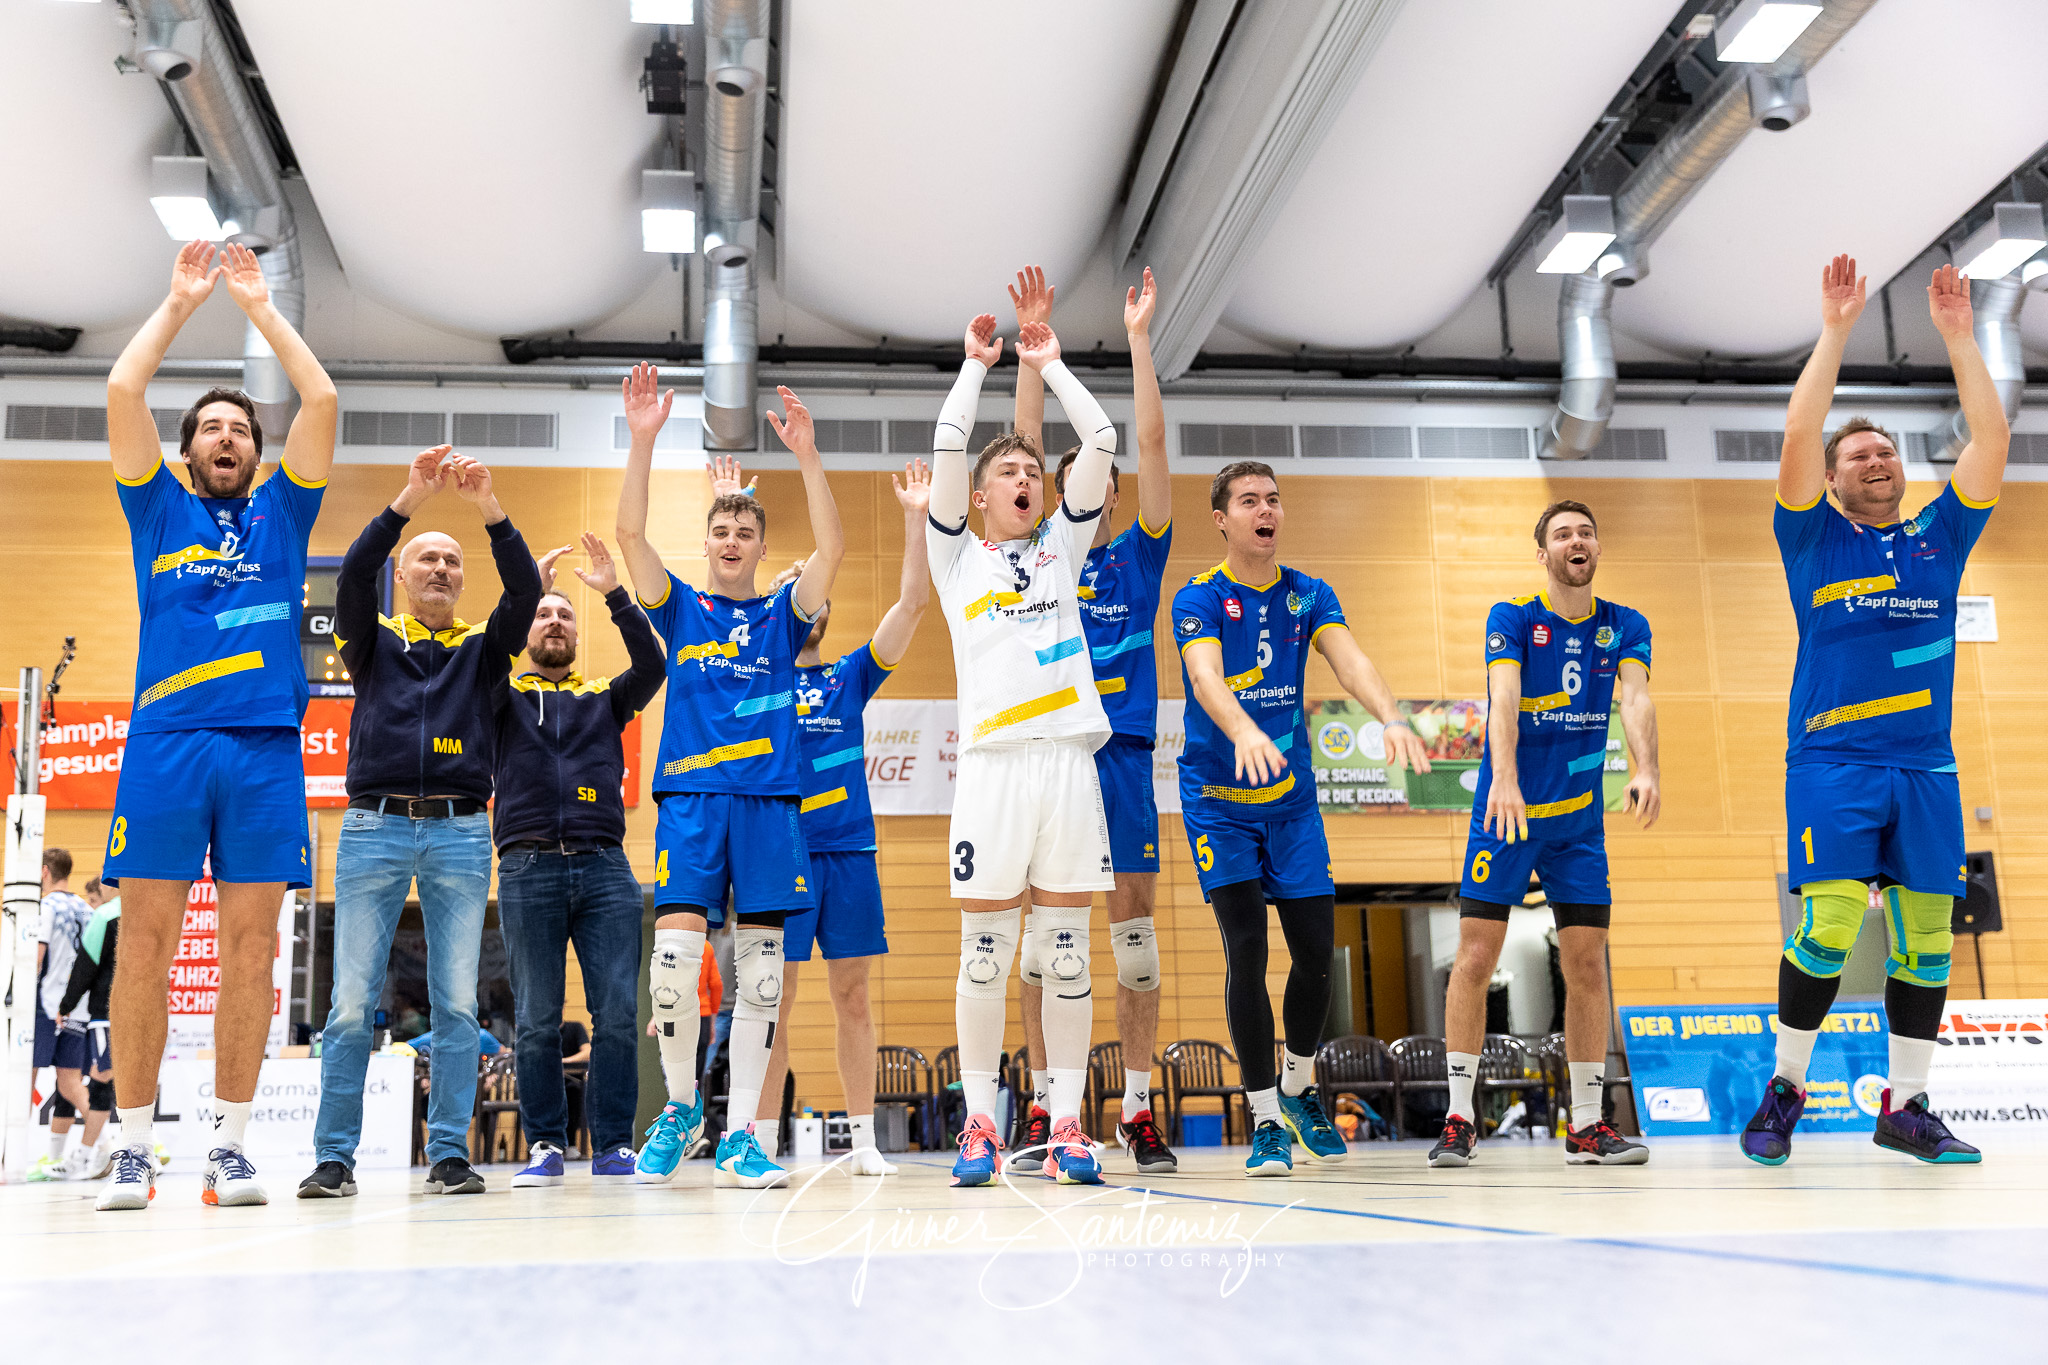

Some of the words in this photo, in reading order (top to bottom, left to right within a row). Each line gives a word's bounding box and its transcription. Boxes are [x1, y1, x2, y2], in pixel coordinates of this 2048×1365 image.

[185, 562, 218, 576] Zapf
[217, 561, 261, 579] Dafuss
[1085, 571, 1099, 591] 7
[1856, 596, 1888, 609] Zapf
[1889, 597, 1940, 611] Daigfuss
[728, 623, 752, 647] 4
[1256, 629, 1273, 669] 5
[1561, 660, 1582, 696] 6
[795, 688, 824, 707] 12
[1239, 690, 1260, 701] Zapf
[300, 724, 339, 755] ist
[433, 737, 463, 755] MM
[1331, 768, 1389, 784] SCHWAIG.
[577, 786, 597, 802] SB
[1332, 788, 1356, 804] DIE
[1357, 788, 1409, 804] REGION.
[109, 816, 128, 858] 8
[1801, 826, 1815, 865] 1
[953, 841, 975, 881] 3
[1196, 834, 1214, 872] 5
[655, 849, 670, 888] 4
[1471, 850, 1492, 884] 6
[761, 949, 776, 957] errea
[976, 944, 995, 954] errea
[1055, 941, 1074, 950] errea
[660, 960, 677, 969] errea
[1629, 1016, 1675, 1037] DER
[1680, 1014, 1763, 1040] JUGEND
